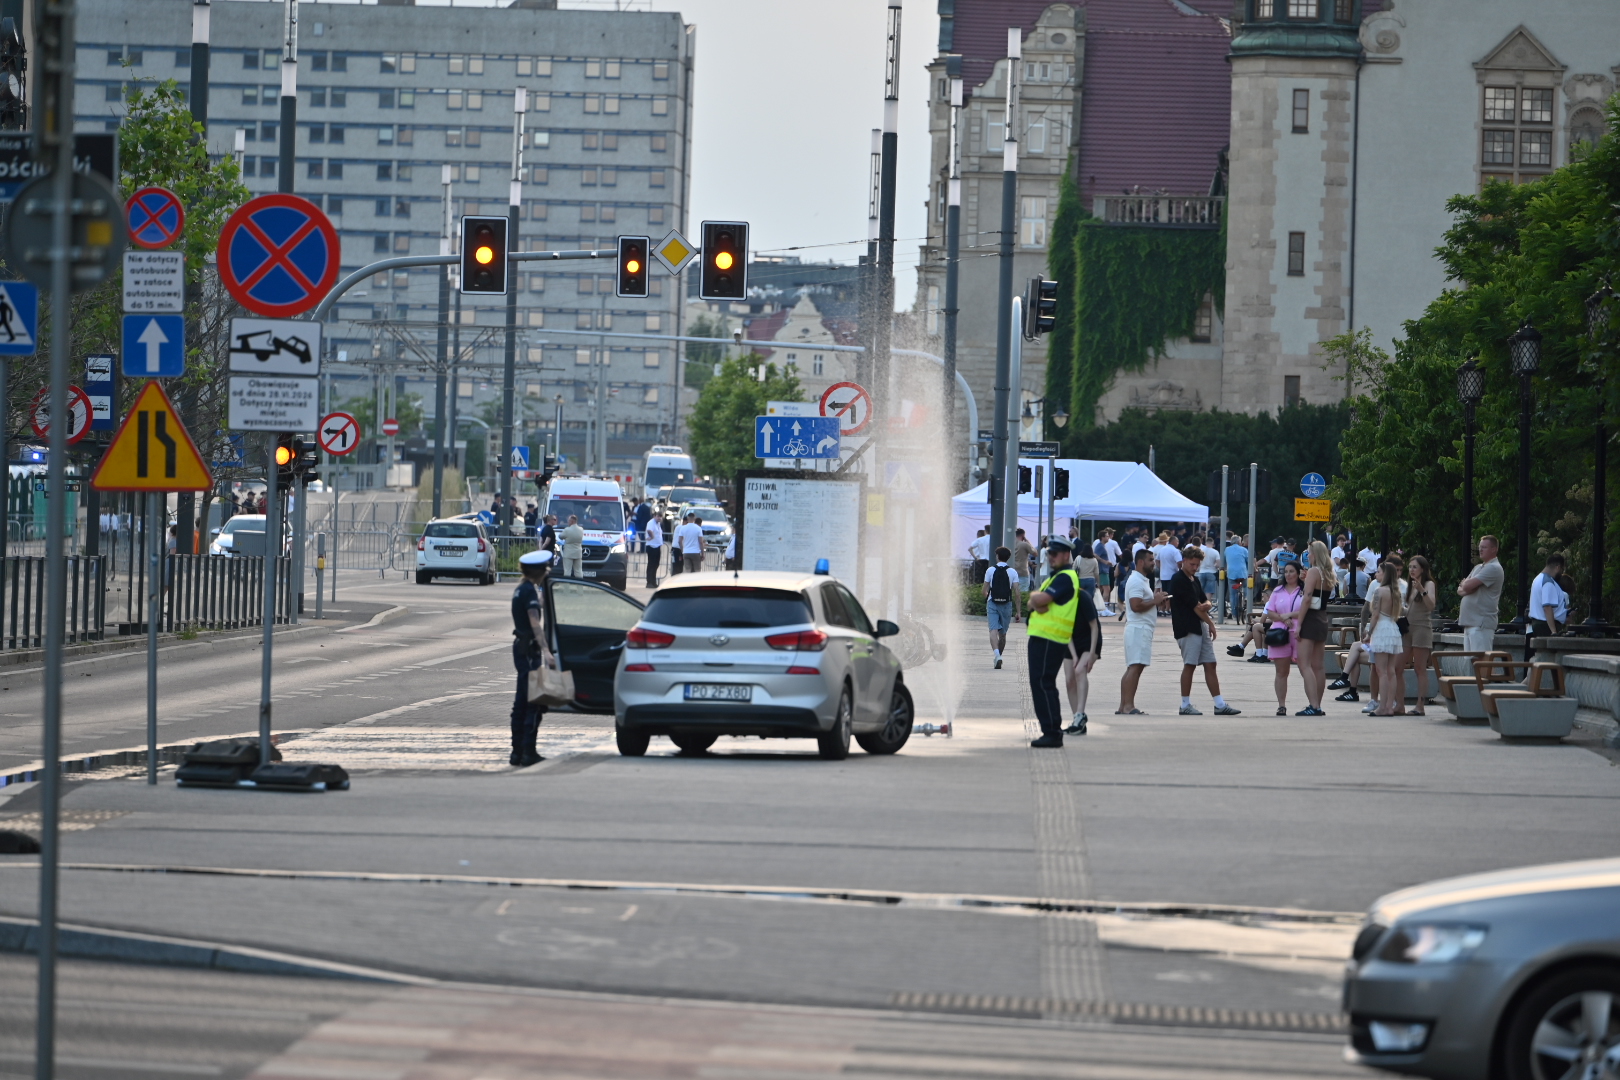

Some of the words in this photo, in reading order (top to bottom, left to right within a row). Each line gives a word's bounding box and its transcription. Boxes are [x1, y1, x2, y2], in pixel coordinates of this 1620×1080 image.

[146, 255, 178, 264] dotyczy
[130, 266, 177, 274] autobusów
[126, 289, 181, 299] autobusowej
[145, 300, 154, 308] 15
[248, 379, 299, 389] Obowiązuje
[232, 389, 243, 397] od
[240, 398, 273, 409] Dotyczy
[260, 409, 287, 417] miejsc
[243, 418, 303, 428] wyznaczonych
[747, 482, 777, 491] FESTIWAL
[761, 493, 772, 501] NAJ
[692, 685, 708, 698] PO
[711, 685, 748, 699] 2FX80
